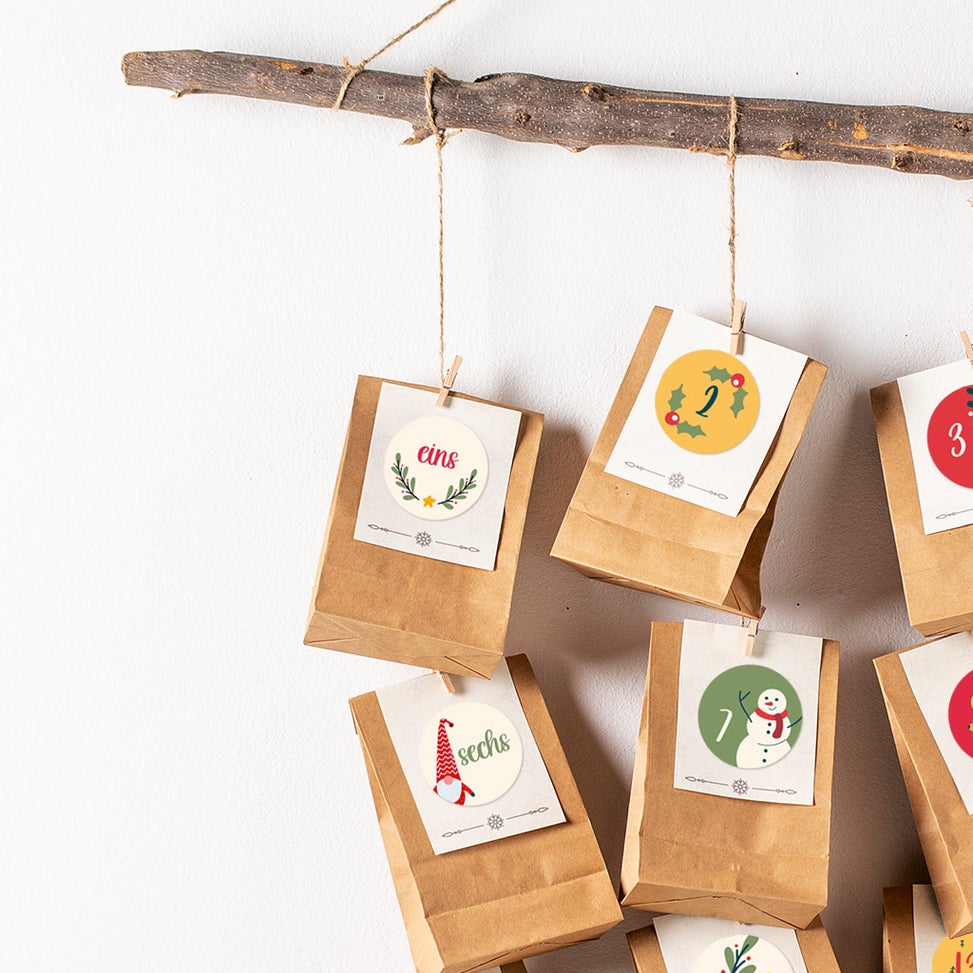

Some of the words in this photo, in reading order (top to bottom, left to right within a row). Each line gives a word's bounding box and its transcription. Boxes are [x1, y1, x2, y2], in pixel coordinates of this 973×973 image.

[695, 385, 719, 418] 2
[417, 443, 460, 469] eins
[948, 422, 967, 458] 3
[715, 708, 733, 743] 7
[457, 729, 511, 767] sechs
